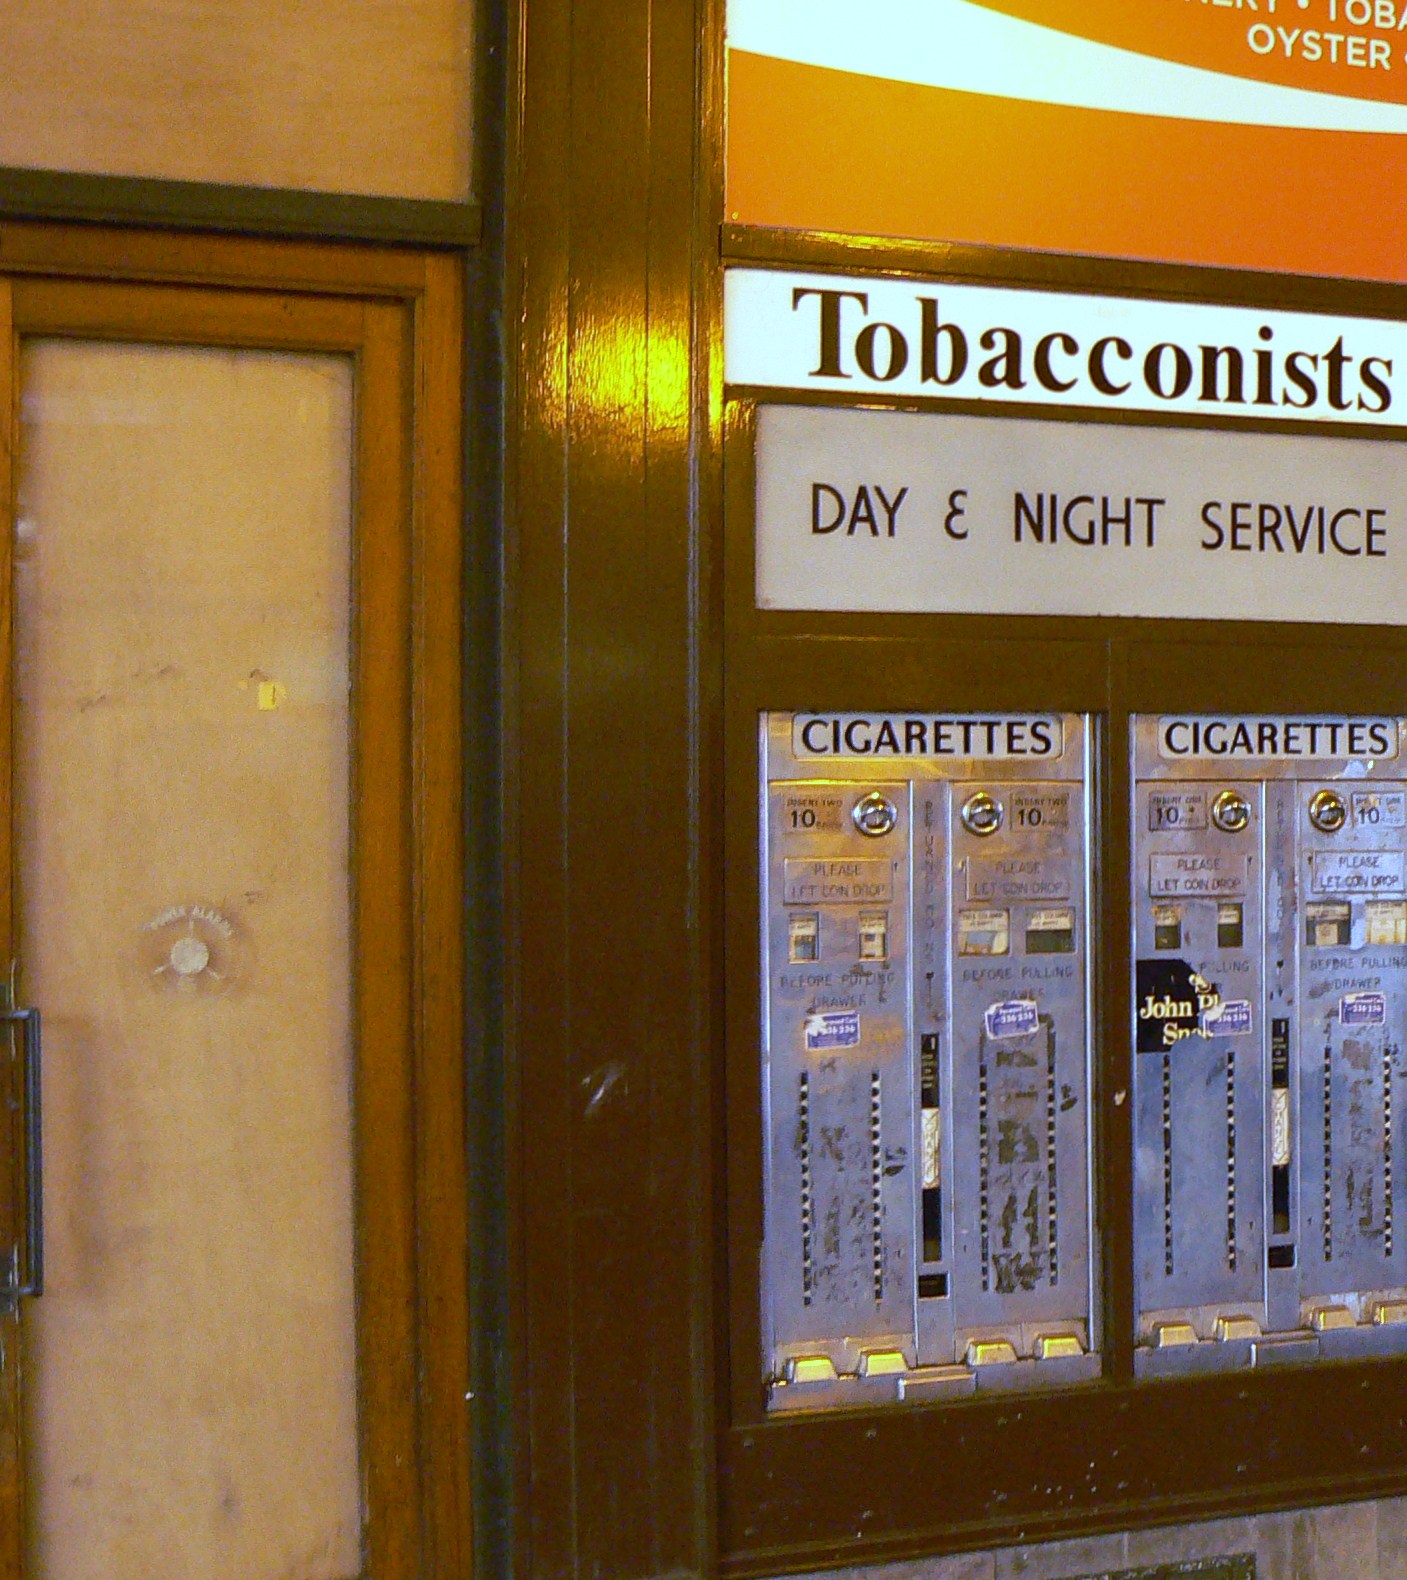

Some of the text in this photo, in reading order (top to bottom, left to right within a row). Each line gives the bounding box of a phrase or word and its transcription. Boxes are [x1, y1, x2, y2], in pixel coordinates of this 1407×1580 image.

[1247, 23, 1391, 71] OYSTER
[792, 287, 1394, 414] Tobacconists
[810, 482, 1388, 556] DAY & NIGHT SERVICE
[801, 719, 1052, 755] CIGARETTES
[1164, 721, 1389, 755] CIGARETTES
[790, 809, 816, 829] 10
[1018, 808, 1042, 827] 10
[1156, 806, 1180, 825] 10
[1358, 807, 1380, 825] 10
[1140, 994, 1193, 1019] John
